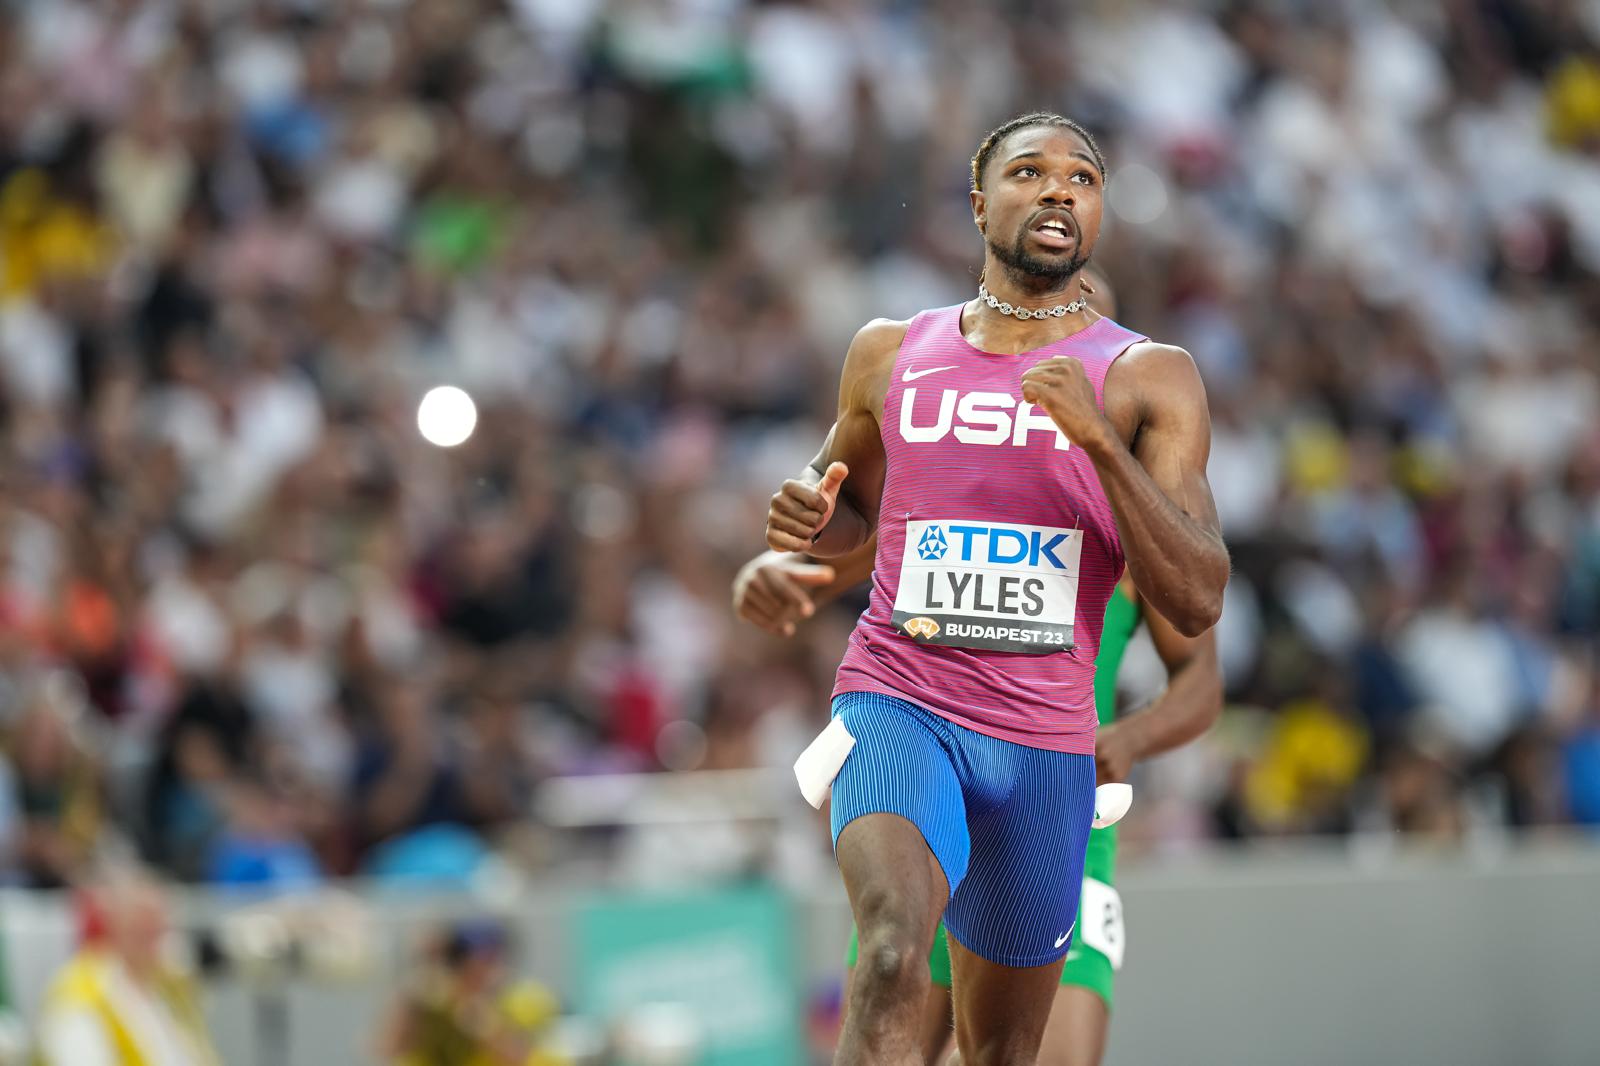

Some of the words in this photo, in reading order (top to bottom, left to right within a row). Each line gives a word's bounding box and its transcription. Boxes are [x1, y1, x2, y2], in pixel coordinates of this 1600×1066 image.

[899, 388, 1070, 451] USA
[948, 526, 1070, 569] TDK
[925, 572, 1044, 616] LYLES
[945, 624, 1041, 644] BUDAPEST
[1043, 631, 1064, 645] 23
